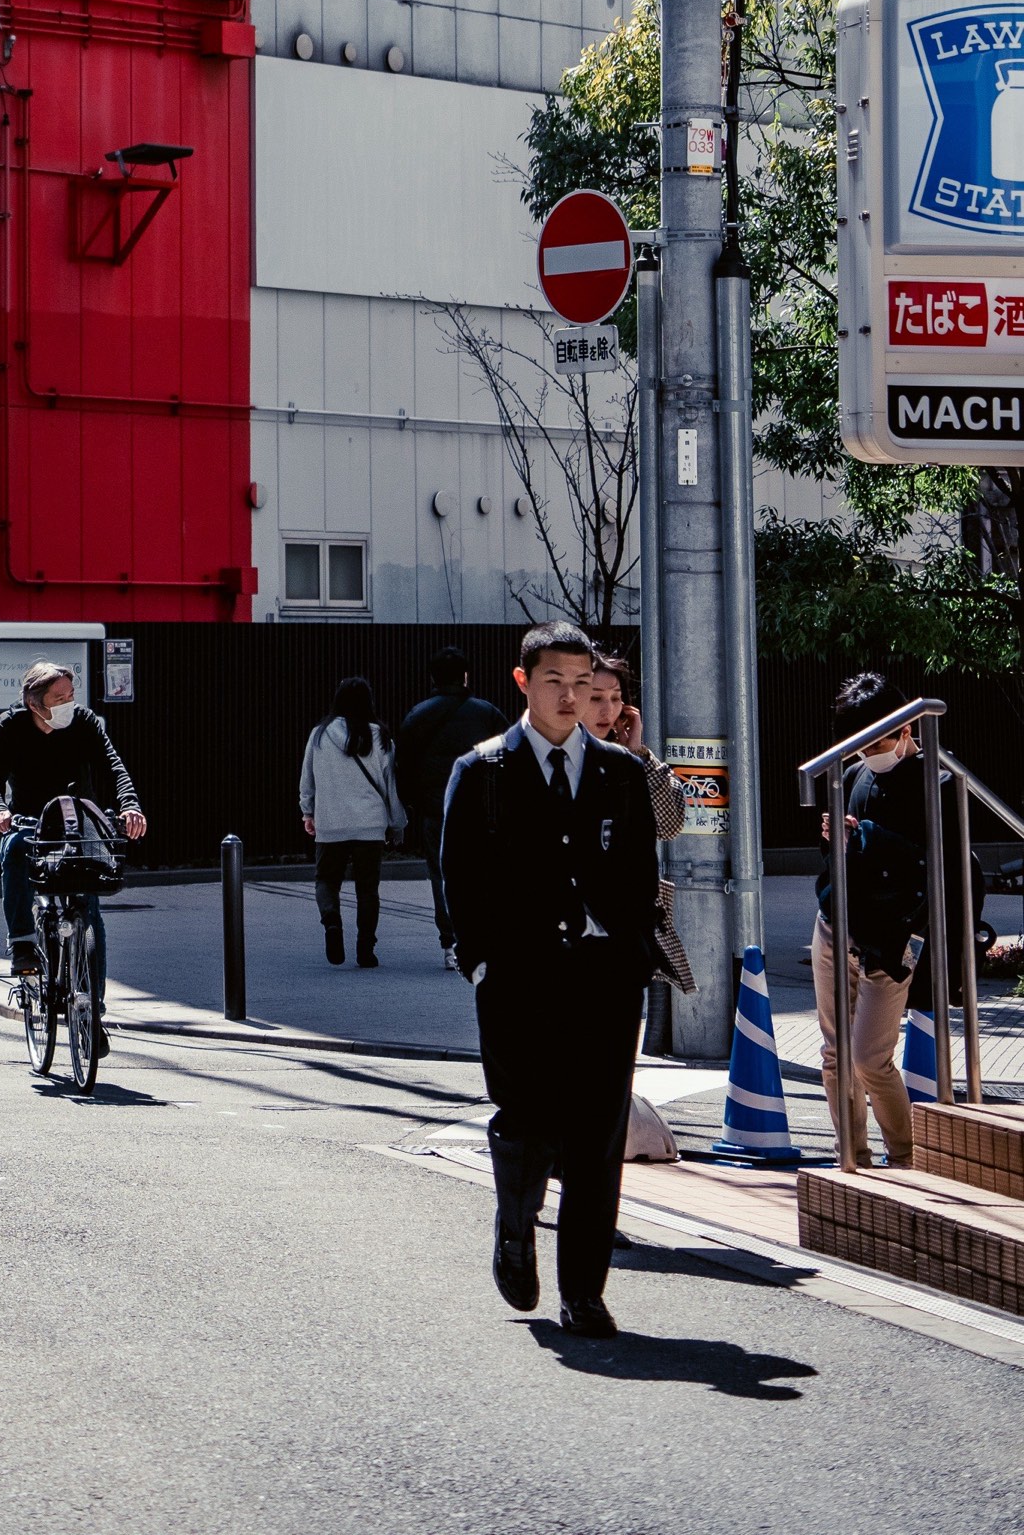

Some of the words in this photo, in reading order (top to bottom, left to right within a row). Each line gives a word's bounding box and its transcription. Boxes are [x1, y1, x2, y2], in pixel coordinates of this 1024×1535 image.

[894, 289, 984, 336] たばこ
[556, 336, 616, 364] 自転車を除く
